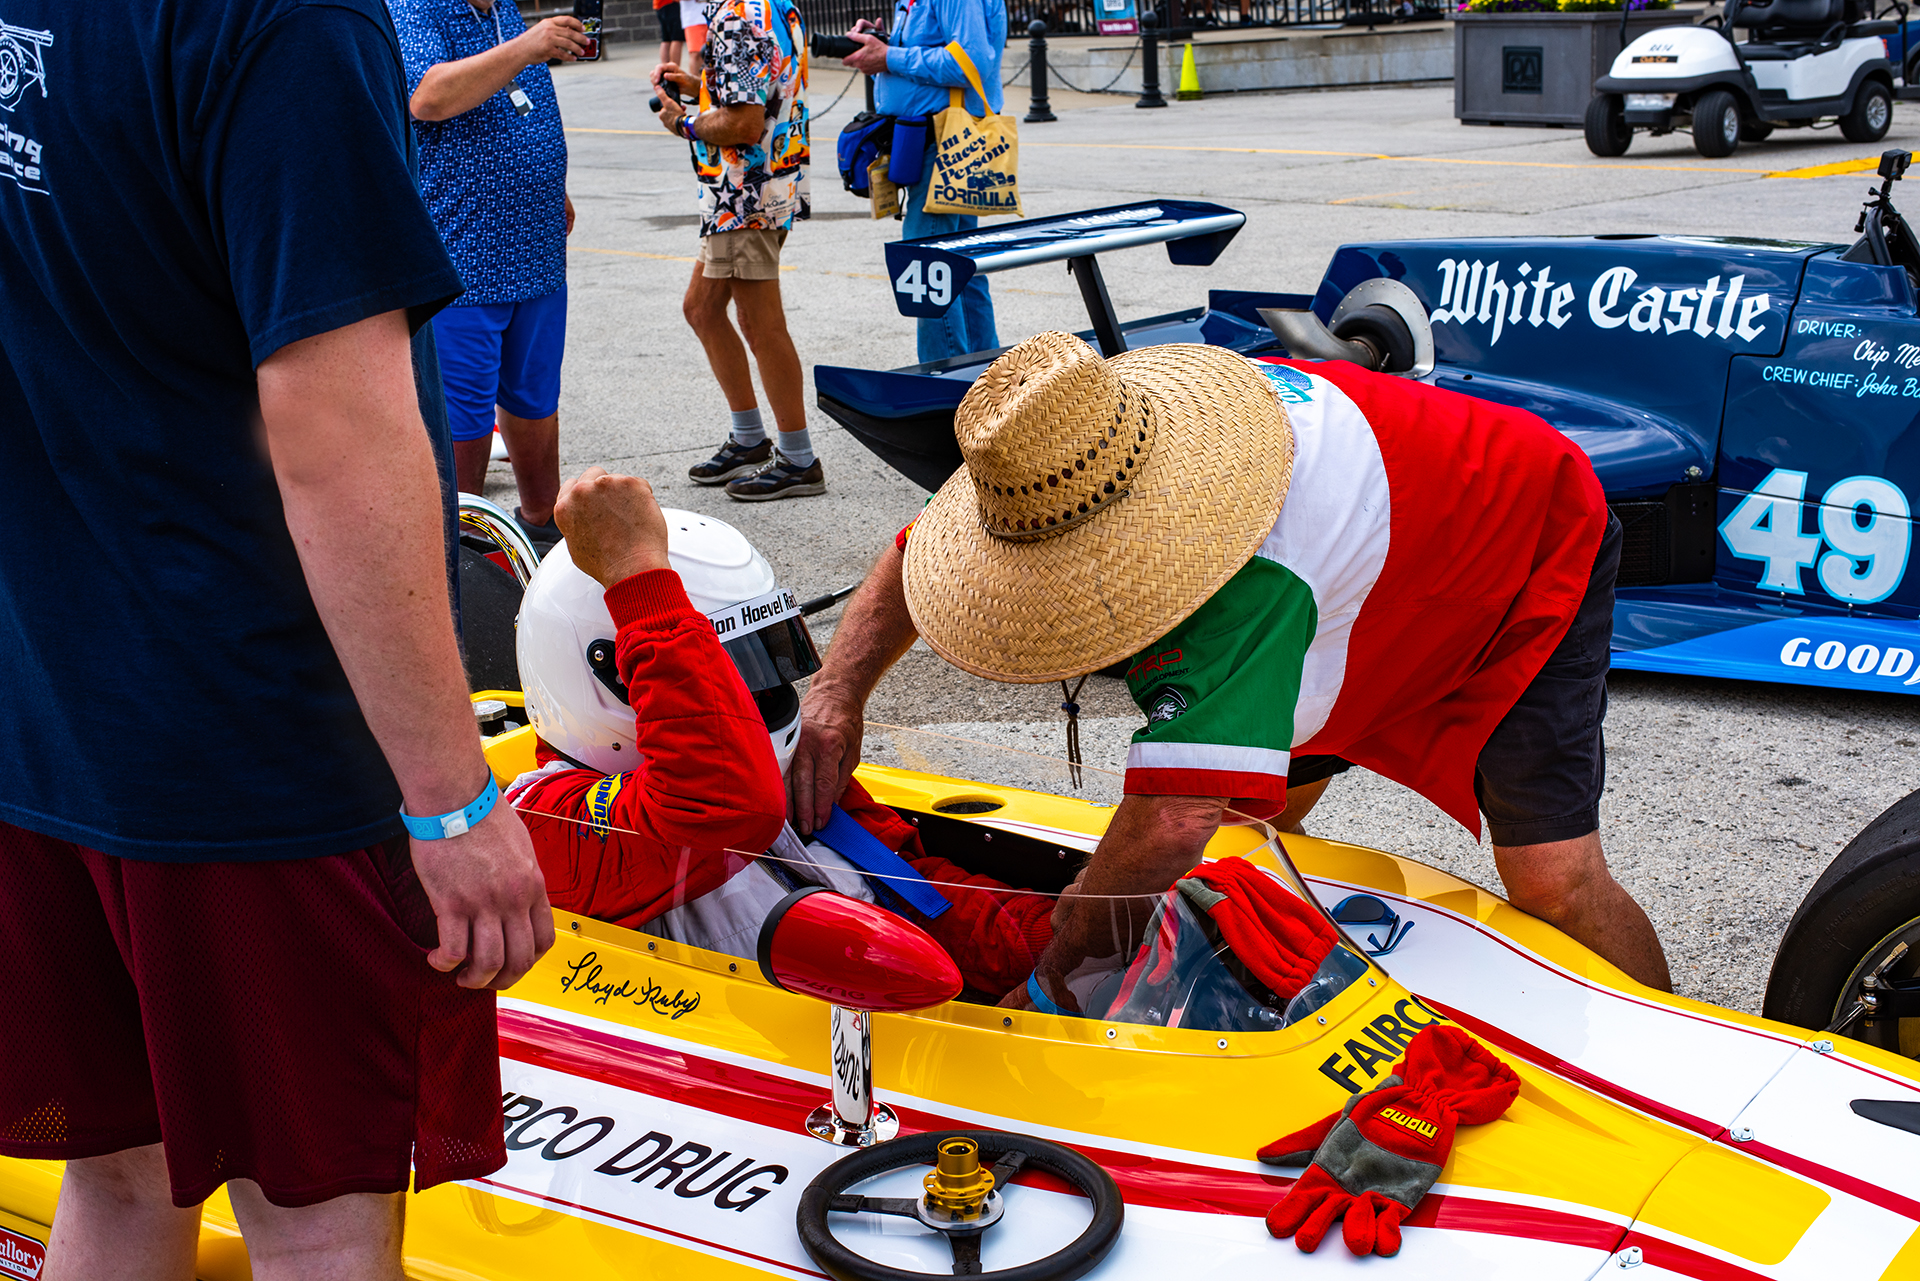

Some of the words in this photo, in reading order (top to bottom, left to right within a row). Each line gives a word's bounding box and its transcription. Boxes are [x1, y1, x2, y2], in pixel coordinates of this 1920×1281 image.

[963, 127, 972, 140] a
[935, 135, 986, 173] Racey
[940, 135, 1010, 186] Person!
[934, 184, 1017, 207] FORMULA
[895, 259, 952, 307] 49
[1429, 257, 1575, 347] White
[1588, 265, 1771, 343] Castle
[1797, 319, 1862, 339] DRIVER:
[1853, 339, 1890, 371] Chip
[1762, 365, 1808, 384] CREW
[1809, 370, 1860, 389] CHIEF:
[1855, 372, 1899, 399] John
[1717, 467, 1913, 605] 49
[741, 595, 784, 627] Hoevel
[1127, 648, 1183, 682] TRD
[561, 951, 637, 1005] Lloyd
[633, 976, 701, 1020] Ruby
[593, 1130, 790, 1213] DRUG
